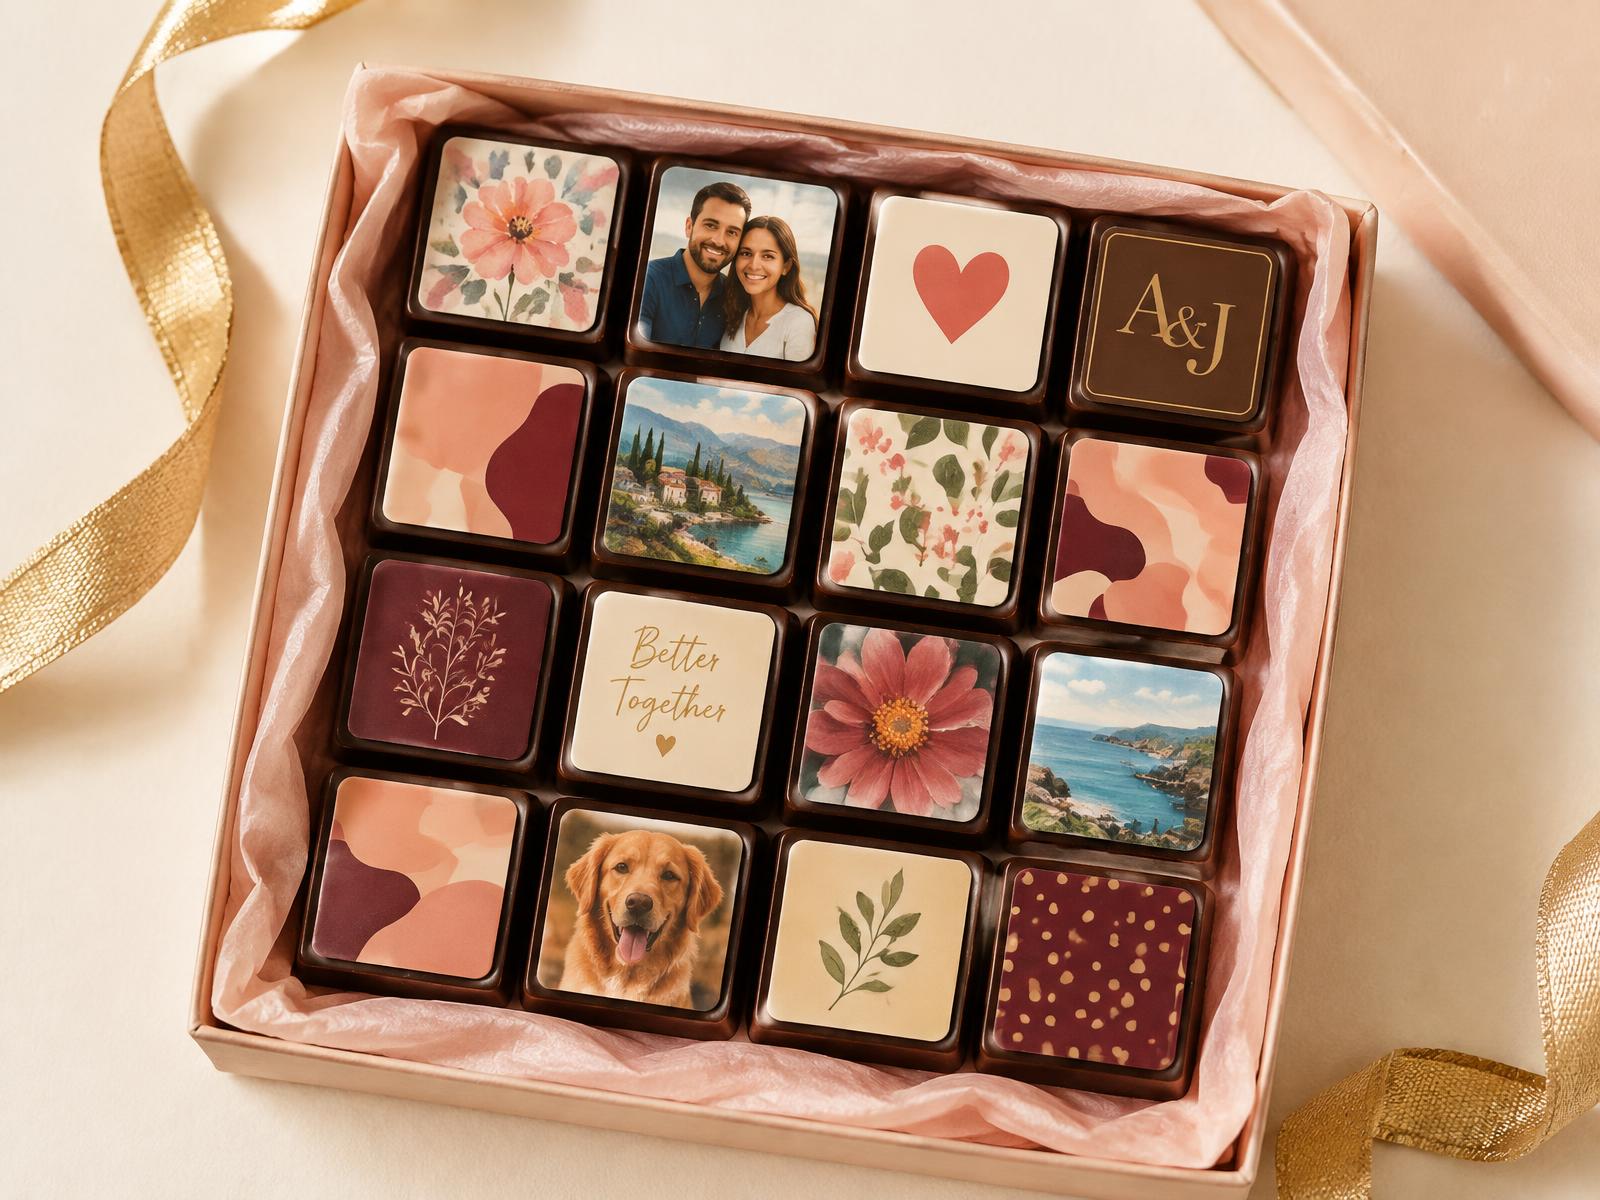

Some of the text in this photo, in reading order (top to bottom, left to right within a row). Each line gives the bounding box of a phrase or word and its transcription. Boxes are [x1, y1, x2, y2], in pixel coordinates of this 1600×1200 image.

[1115, 273, 1237, 376] A&J
[630, 625, 720, 673] Better
[610, 676, 726, 733] Together
